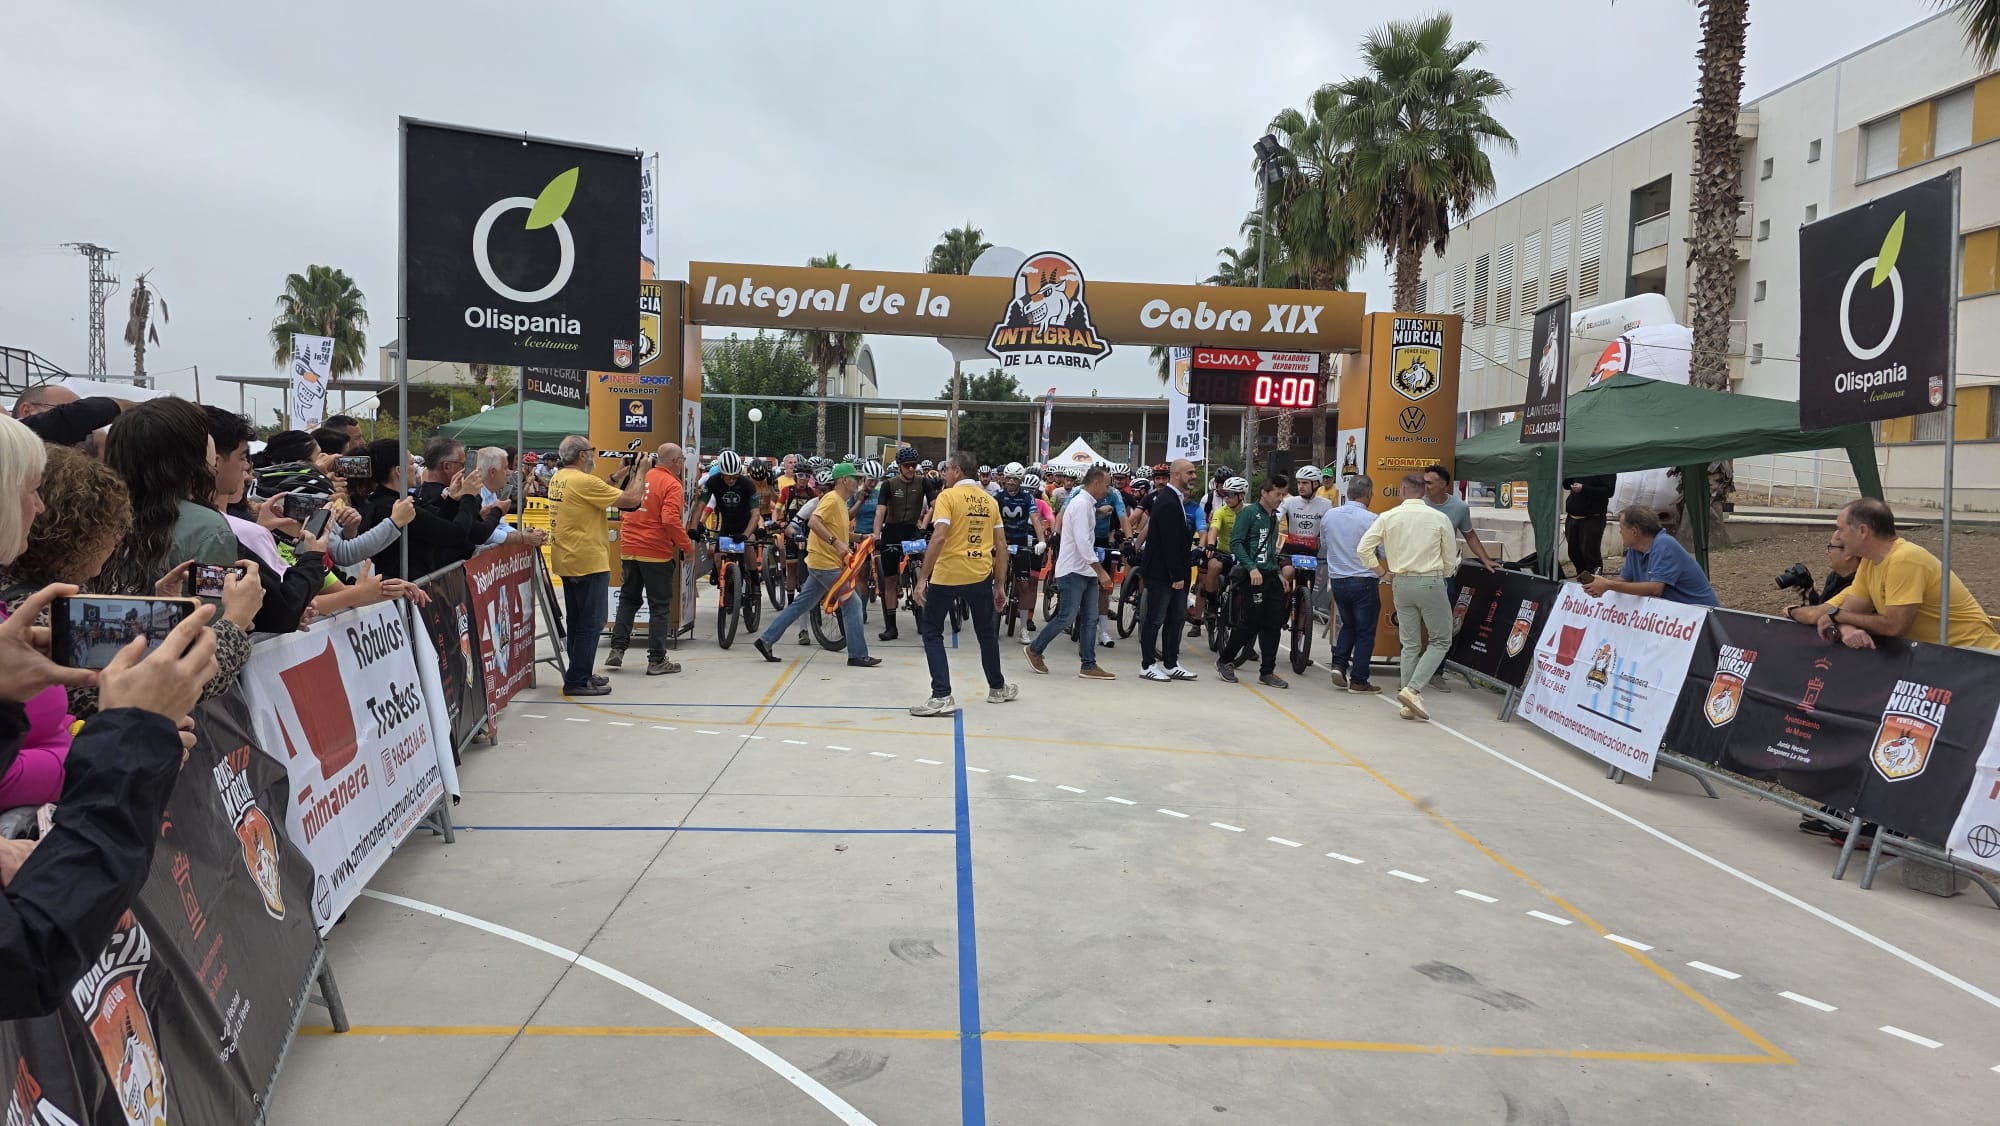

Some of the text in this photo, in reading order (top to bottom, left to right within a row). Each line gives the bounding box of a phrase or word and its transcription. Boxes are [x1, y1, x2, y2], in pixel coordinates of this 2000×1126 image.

[702, 276, 951, 318] Integral de la
[465, 307, 581, 335] Olispania
[1140, 299, 1325, 334] Cabra XIX
[994, 327, 1103, 349] INTEGRAL
[1393, 330, 1442, 346] MURCIA
[1004, 354, 1092, 370] DE LA CABRA
[1272, 354, 1311, 362] MARCADORES
[1272, 363, 1309, 371] DEPORTIVOS
[610, 375, 672, 384] INTERSPORT
[1835, 362, 1907, 393] Olispania
[528, 379, 580, 400] DELACABRA
[1255, 376, 1315, 406] 0:00
[625, 415, 647, 424] DFM
[1524, 421, 1560, 435] DELACABRA
[1416, 436, 1440, 444] Motor
[1387, 458, 1440, 466] NORMATEX
[1294, 512, 1322, 520] TRICICLÓN
[1628, 610, 1697, 641] Publicidad
[347, 613, 404, 669] Rótulos
[1717, 655, 1753, 677] MURCIA
[366, 682, 420, 738] Trofeos
[1885, 693, 1946, 724] MURCIA
[1784, 714, 1820, 730] Ayuntamiento
[1793, 727, 1812, 739] Murcia
[221, 769, 254, 824] MURCIA
[302, 764, 369, 845] mimanera
